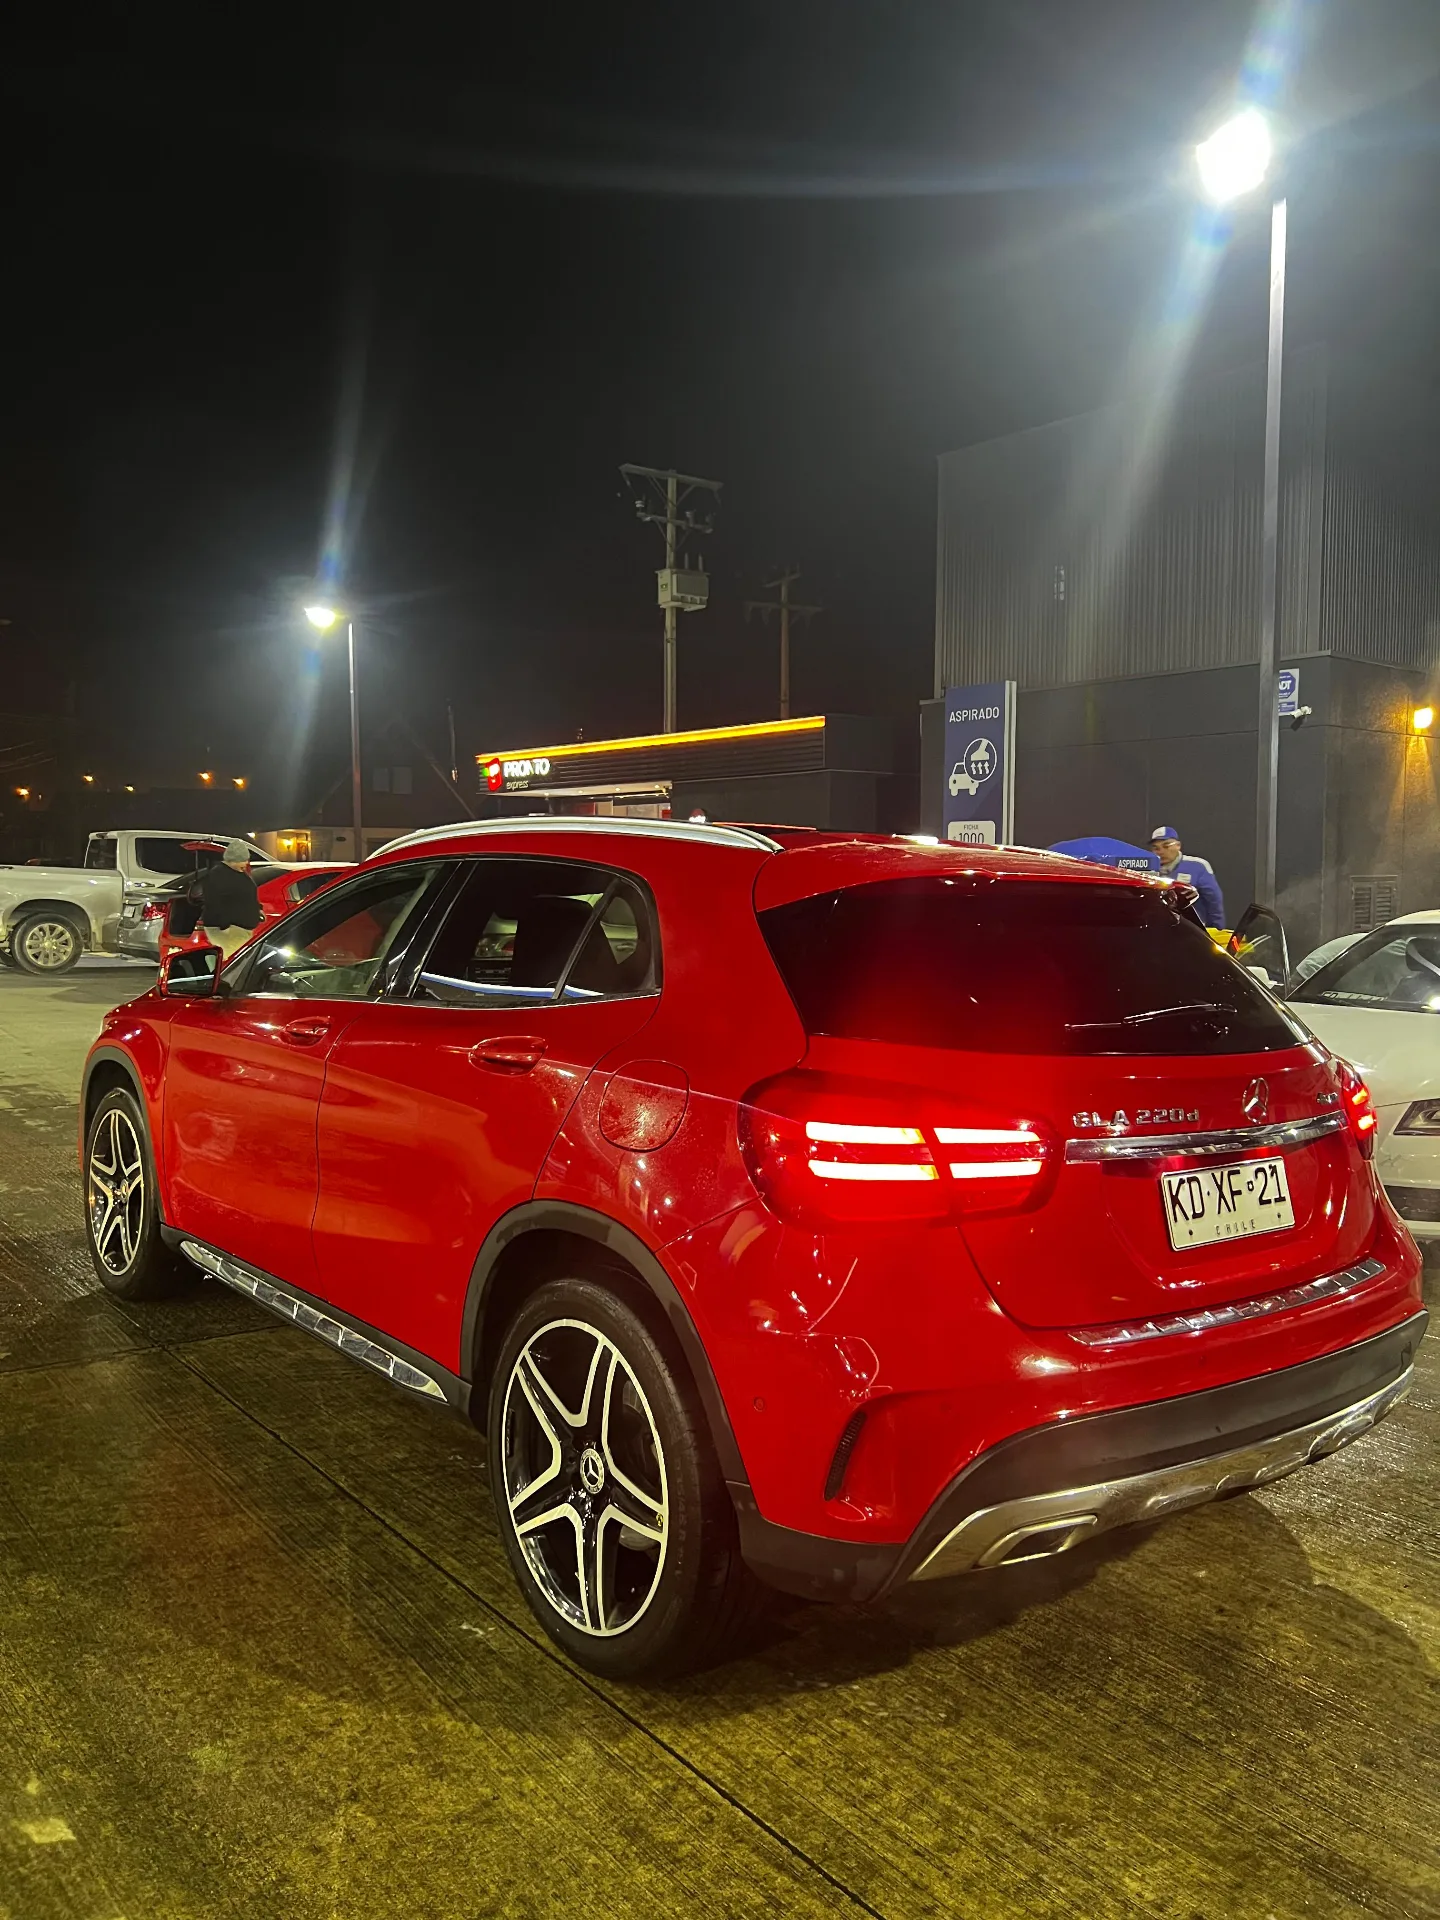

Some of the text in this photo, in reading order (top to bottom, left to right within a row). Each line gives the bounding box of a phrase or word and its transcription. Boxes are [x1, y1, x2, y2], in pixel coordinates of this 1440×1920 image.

[949, 706, 1000, 723] ASPIRADO
[503, 758, 550, 777] PRONTO
[506, 780, 529, 791] express
[1118, 859, 1148, 868] ASPIRADO
[1073, 1108, 1199, 1128] GLA 220d
[1215, 1218, 1256, 1236] CHILE
